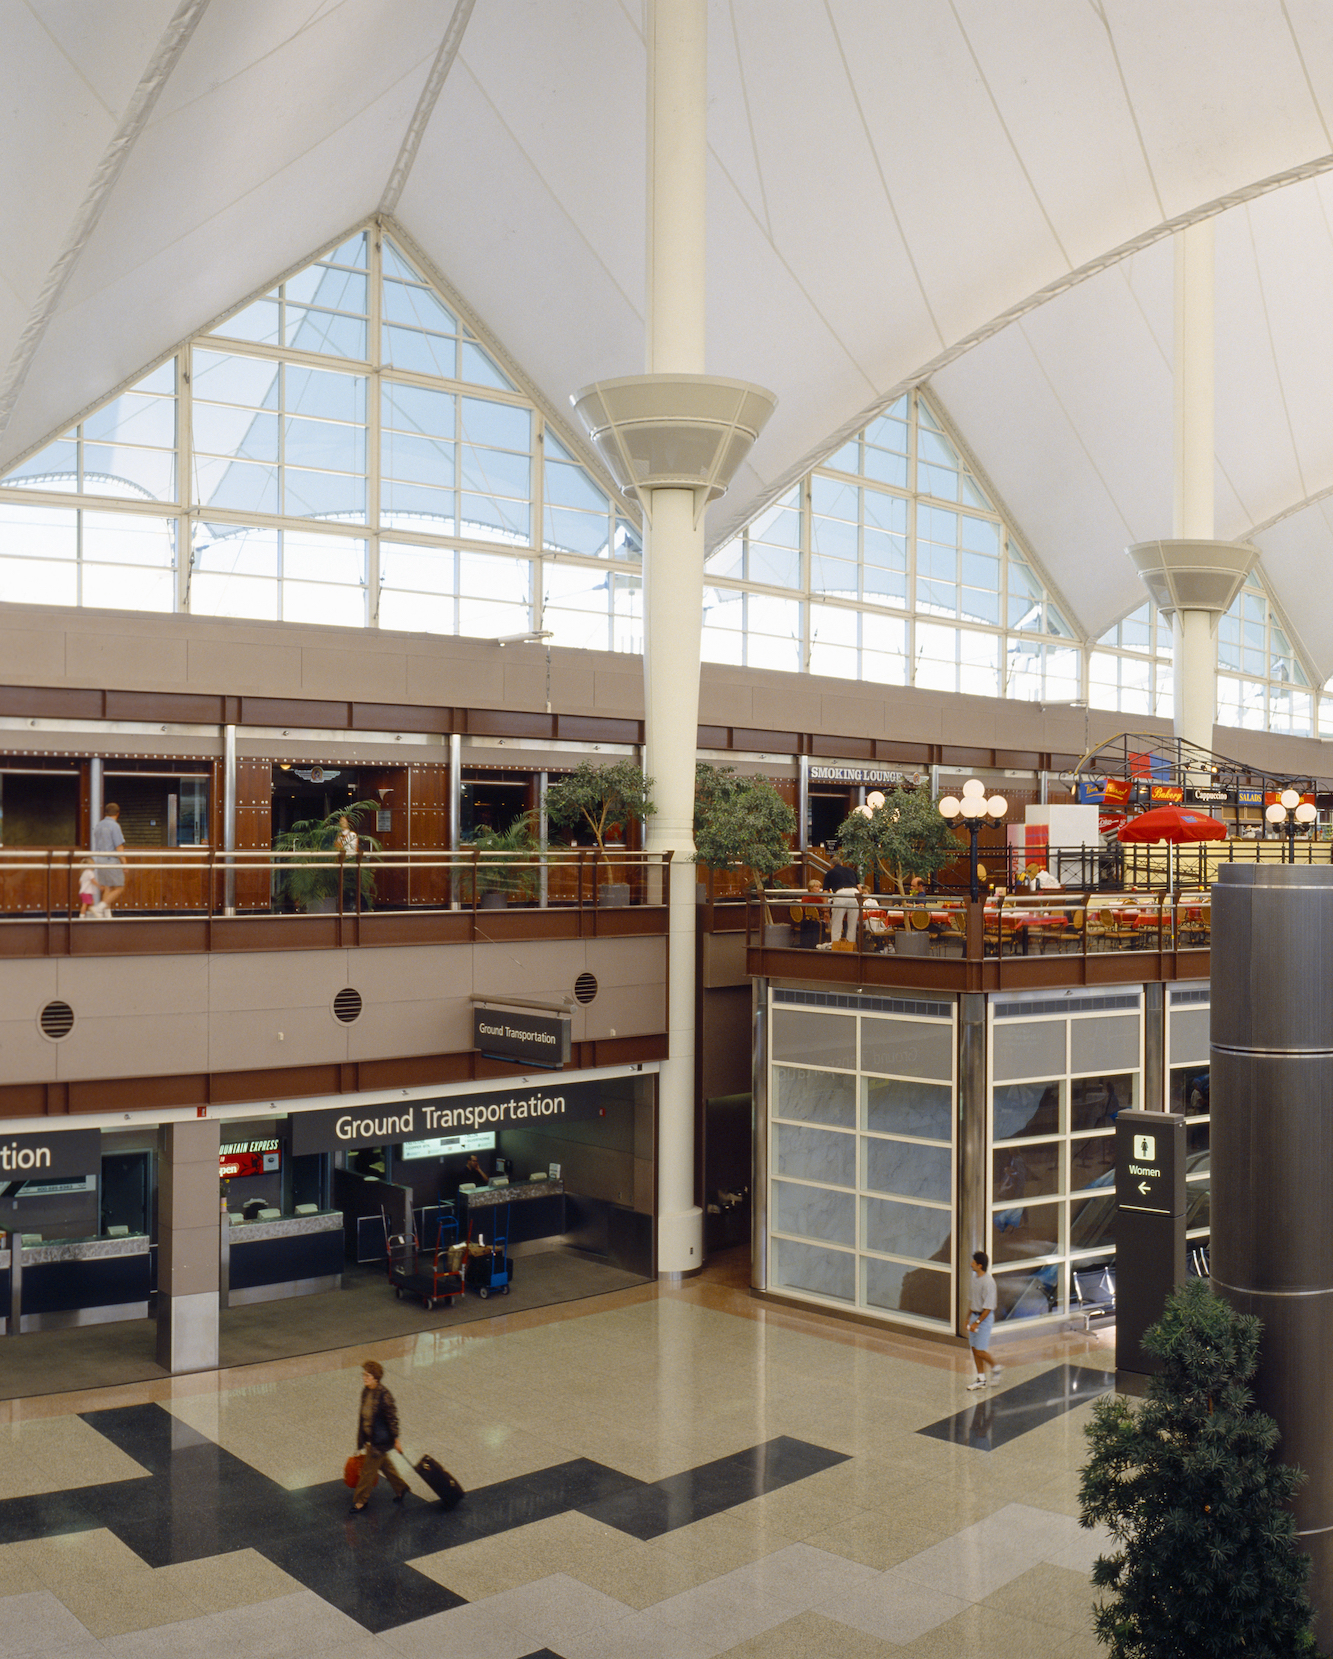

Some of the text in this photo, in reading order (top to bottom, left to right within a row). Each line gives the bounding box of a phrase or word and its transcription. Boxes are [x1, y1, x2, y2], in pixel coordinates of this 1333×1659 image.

[811, 766, 902, 782] SMOKING LOUNGE
[1152, 787, 1182, 802] Bakery
[1194, 790, 1228, 802] Cappuccino
[1238, 793, 1262, 802] SALADS
[479, 1022, 556, 1044] Ground Transportation
[336, 1093, 566, 1140] Ground Transportation
[249, 1139, 279, 1152] EXPRESS
[0, 1142, 51, 1170] tion
[1128, 1164, 1161, 1177] Women
